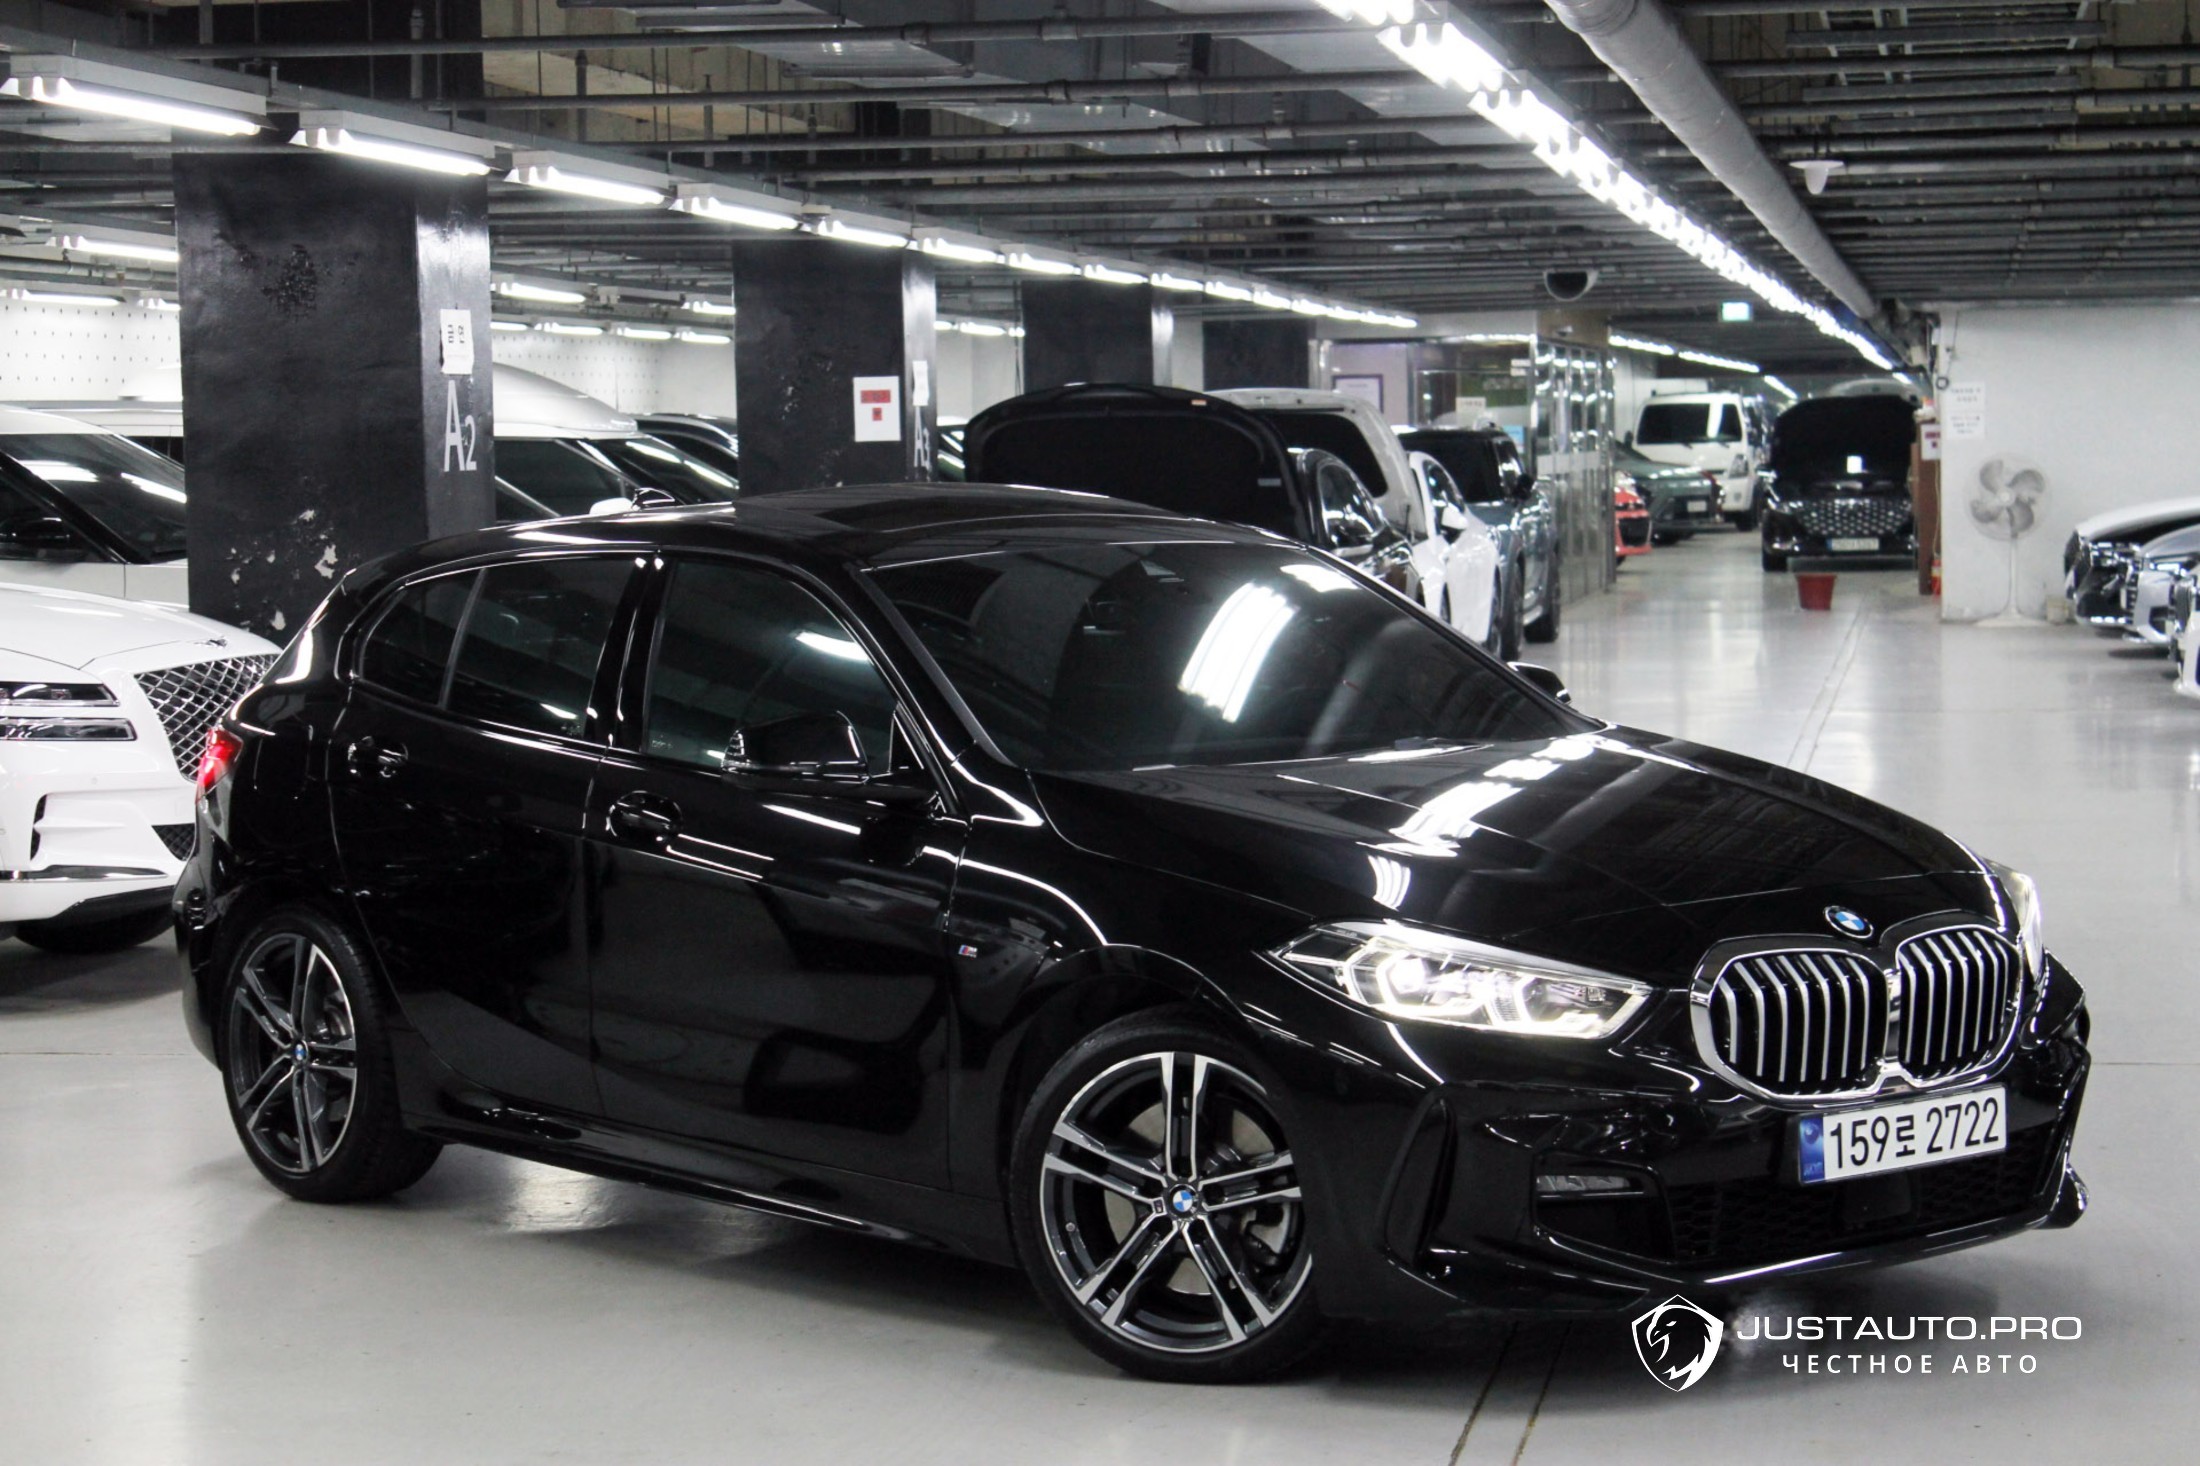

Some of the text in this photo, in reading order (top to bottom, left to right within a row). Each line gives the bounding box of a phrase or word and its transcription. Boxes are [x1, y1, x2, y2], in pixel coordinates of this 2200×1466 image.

[444, 379, 477, 472] A2
[1830, 1097, 1999, 1169] 159로 2722
